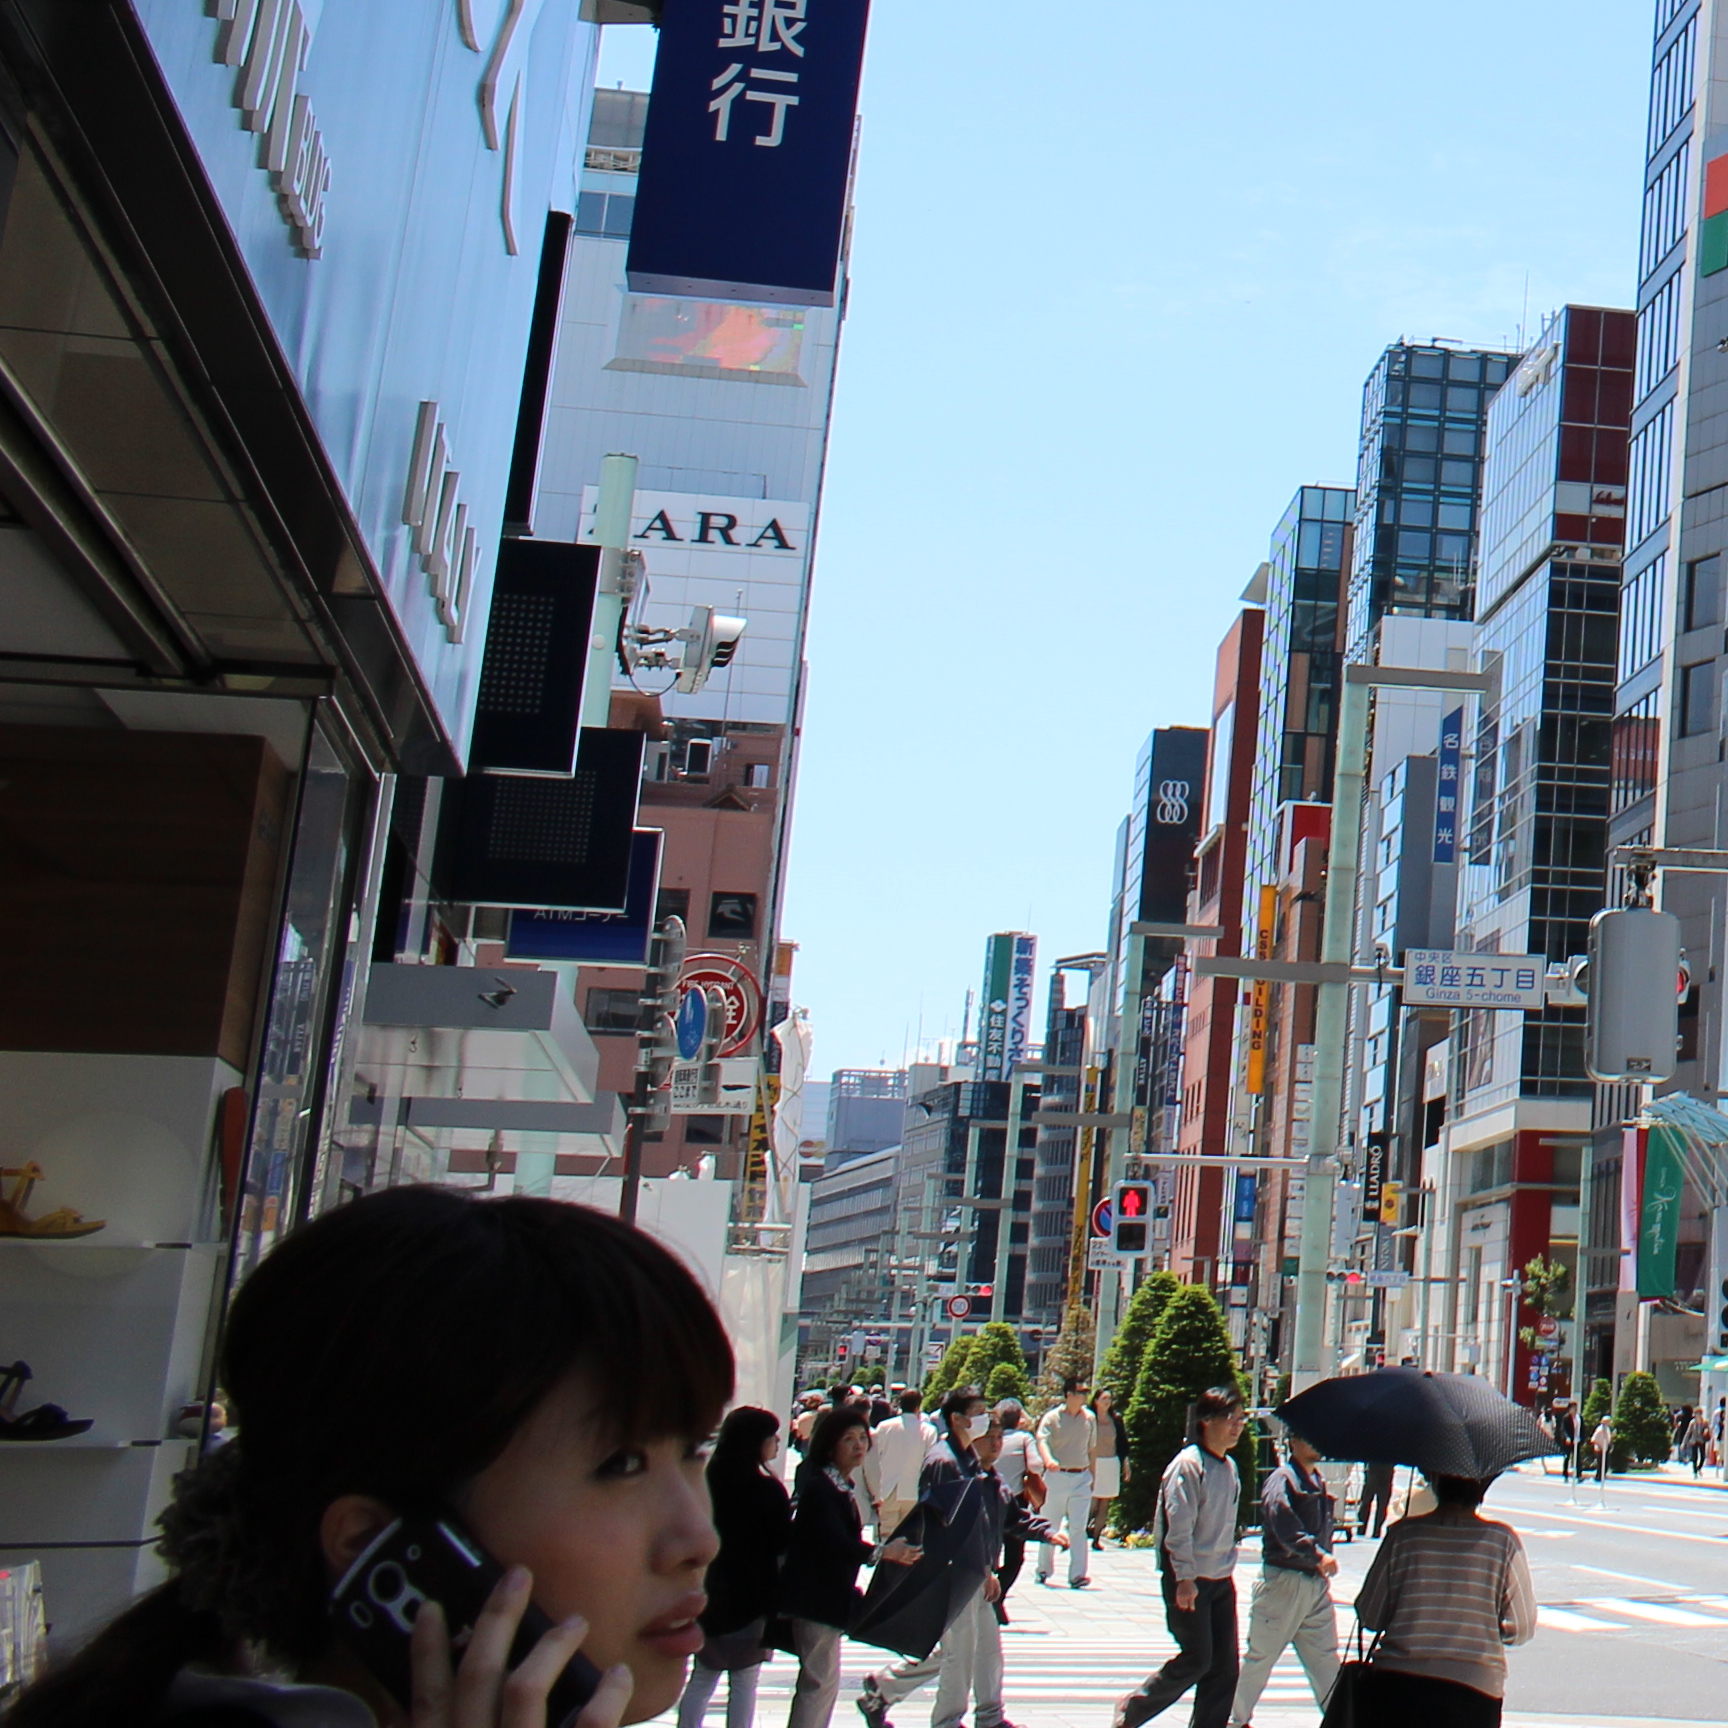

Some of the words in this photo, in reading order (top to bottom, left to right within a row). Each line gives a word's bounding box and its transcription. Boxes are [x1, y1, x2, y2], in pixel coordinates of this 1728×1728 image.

[587, 502, 798, 552] ARA
[1436, 732, 1461, 845] 名鉄観光
[1259, 930, 1270, 960] CSS
[1414, 951, 1453, 964] 中央区
[1413, 964, 1536, 991] 銀座五丁目
[1425, 988, 1461, 1001] Ginza
[1466, 989, 1522, 1003] 5-chome
[1251, 972, 1263, 1050] UILDING
